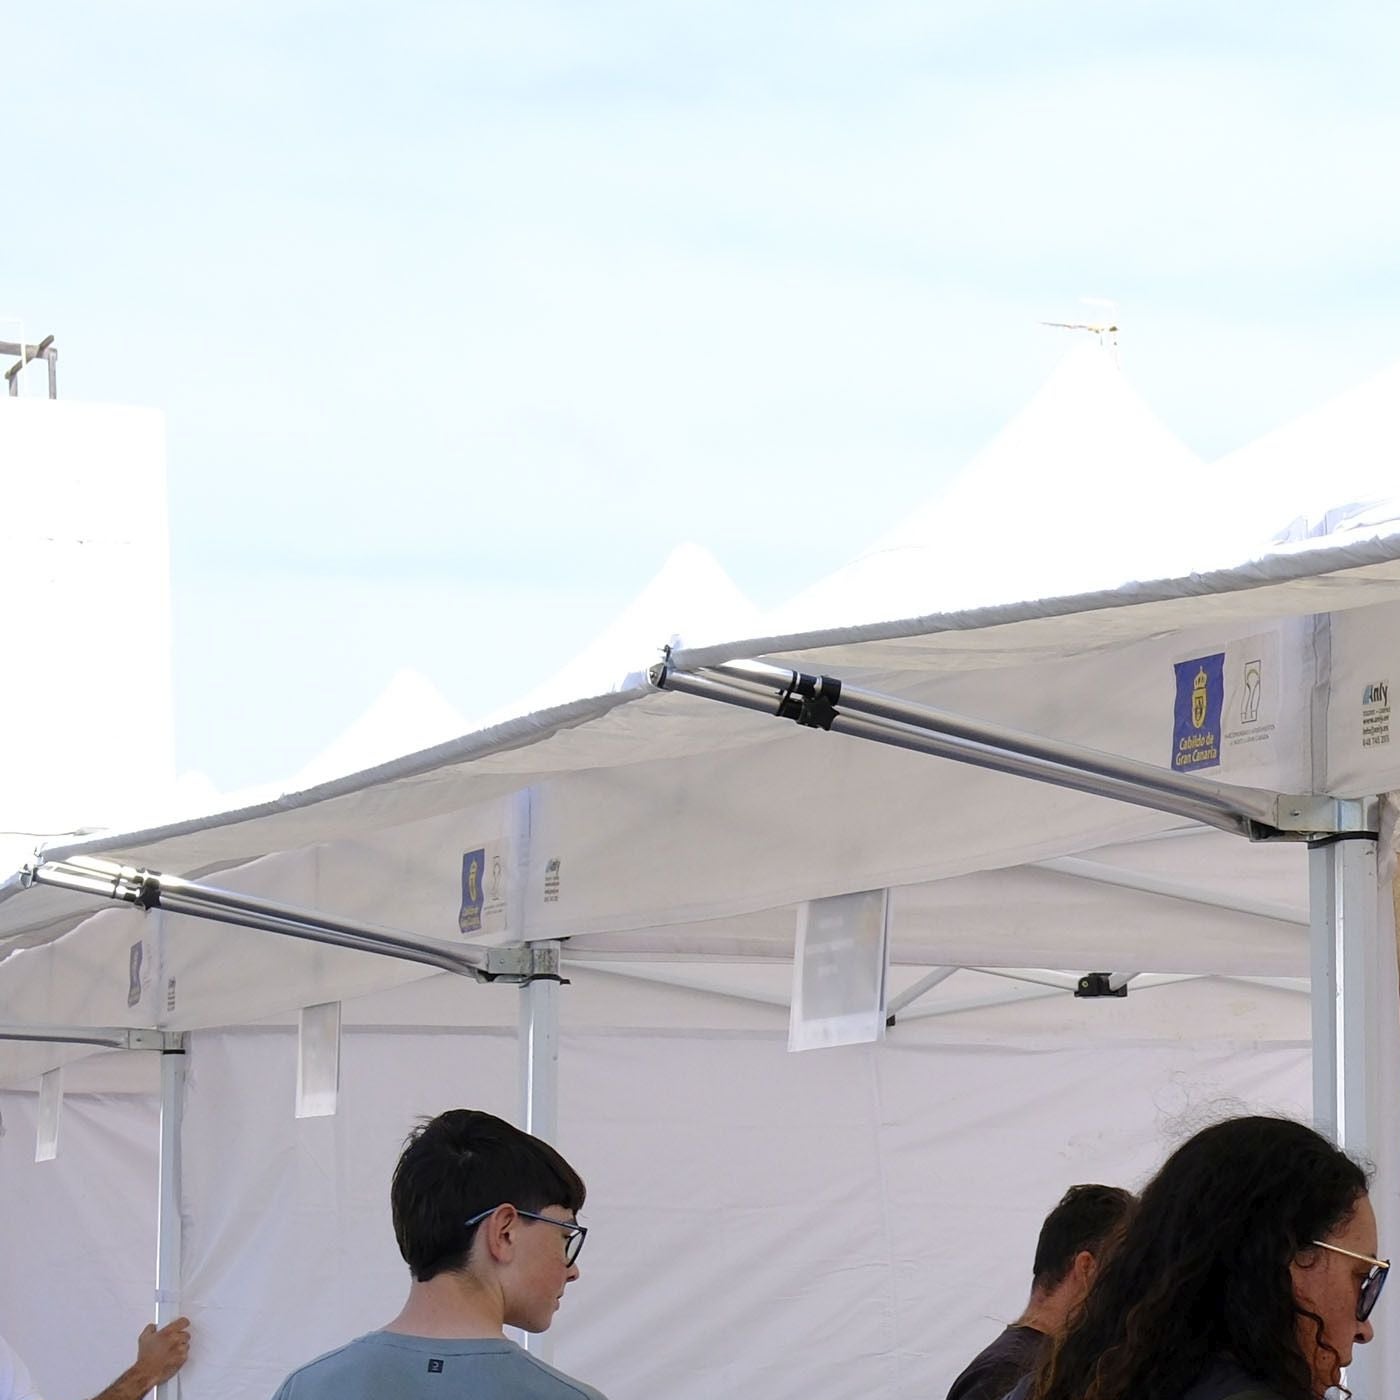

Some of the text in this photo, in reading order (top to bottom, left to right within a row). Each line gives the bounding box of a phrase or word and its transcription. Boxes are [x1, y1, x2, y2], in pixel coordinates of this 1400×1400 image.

[1179, 733, 1205, 750] Cabildo
[1205, 731, 1214, 746] de
[1175, 752, 1192, 766] Gran
